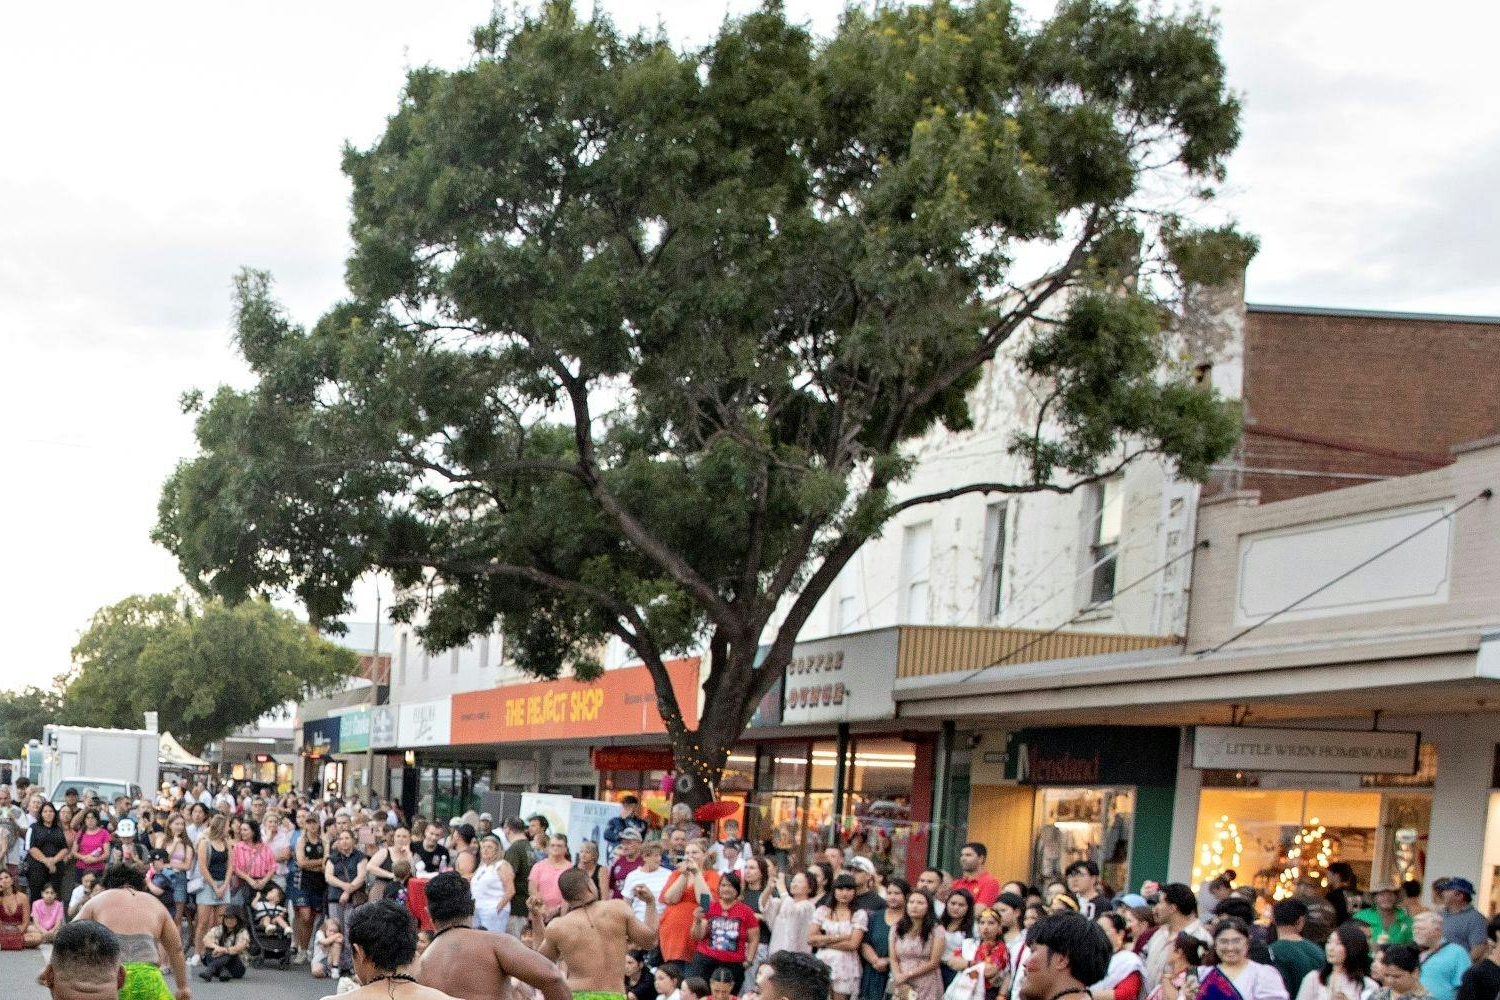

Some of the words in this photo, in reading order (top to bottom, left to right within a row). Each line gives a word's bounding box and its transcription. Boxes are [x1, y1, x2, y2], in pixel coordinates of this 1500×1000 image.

[506, 698, 524, 726] THE
[527, 689, 566, 725] REJECT
[570, 687, 604, 721] SHOP
[1225, 743, 1271, 756] LITTLE
[1275, 745, 1315, 757] WREN
[1319, 745, 1408, 759] HOMEWARES
